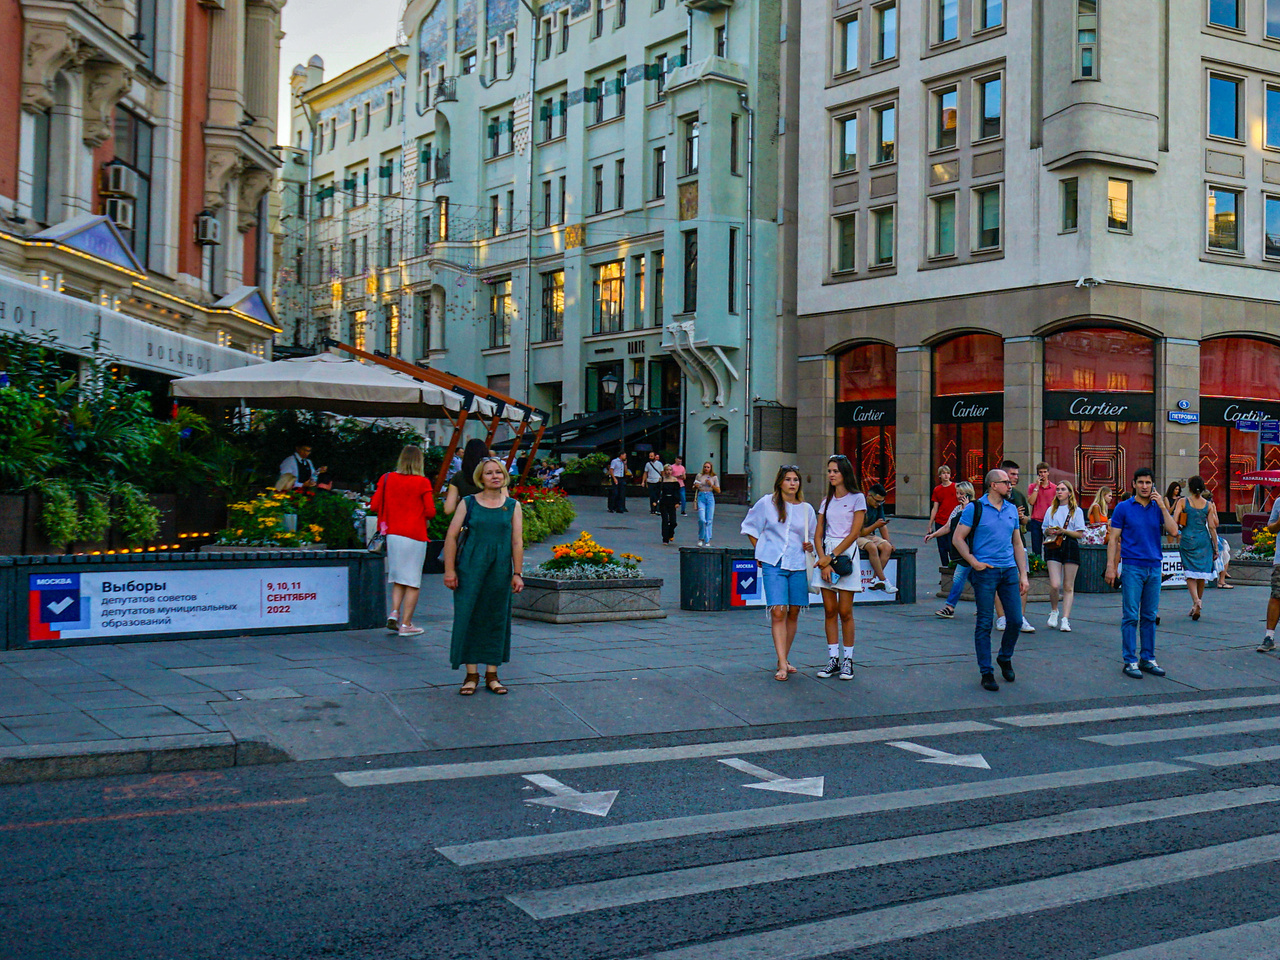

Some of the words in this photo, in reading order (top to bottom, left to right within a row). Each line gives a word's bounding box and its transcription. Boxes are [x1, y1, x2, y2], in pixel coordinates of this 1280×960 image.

[147, 342, 211, 372] BOLSHOI
[952, 400, 989, 418] Cartier
[1069, 396, 1128, 416] Cartier
[853, 406, 886, 422] Cartier
[102, 580, 166, 593] Выборы
[266, 582, 275, 592] 9,
[277, 582, 289, 591] 10,
[291, 581, 301, 590] 11
[101, 595, 155, 606] депутатов
[157, 593, 198, 603] советов
[266, 592, 317, 602] СЕНТЯБРЯ
[101, 607, 155, 618] депутатов
[157, 603, 238, 616] муниципальных
[266, 605, 291, 614] 2022
[101, 617, 172, 629] образований
